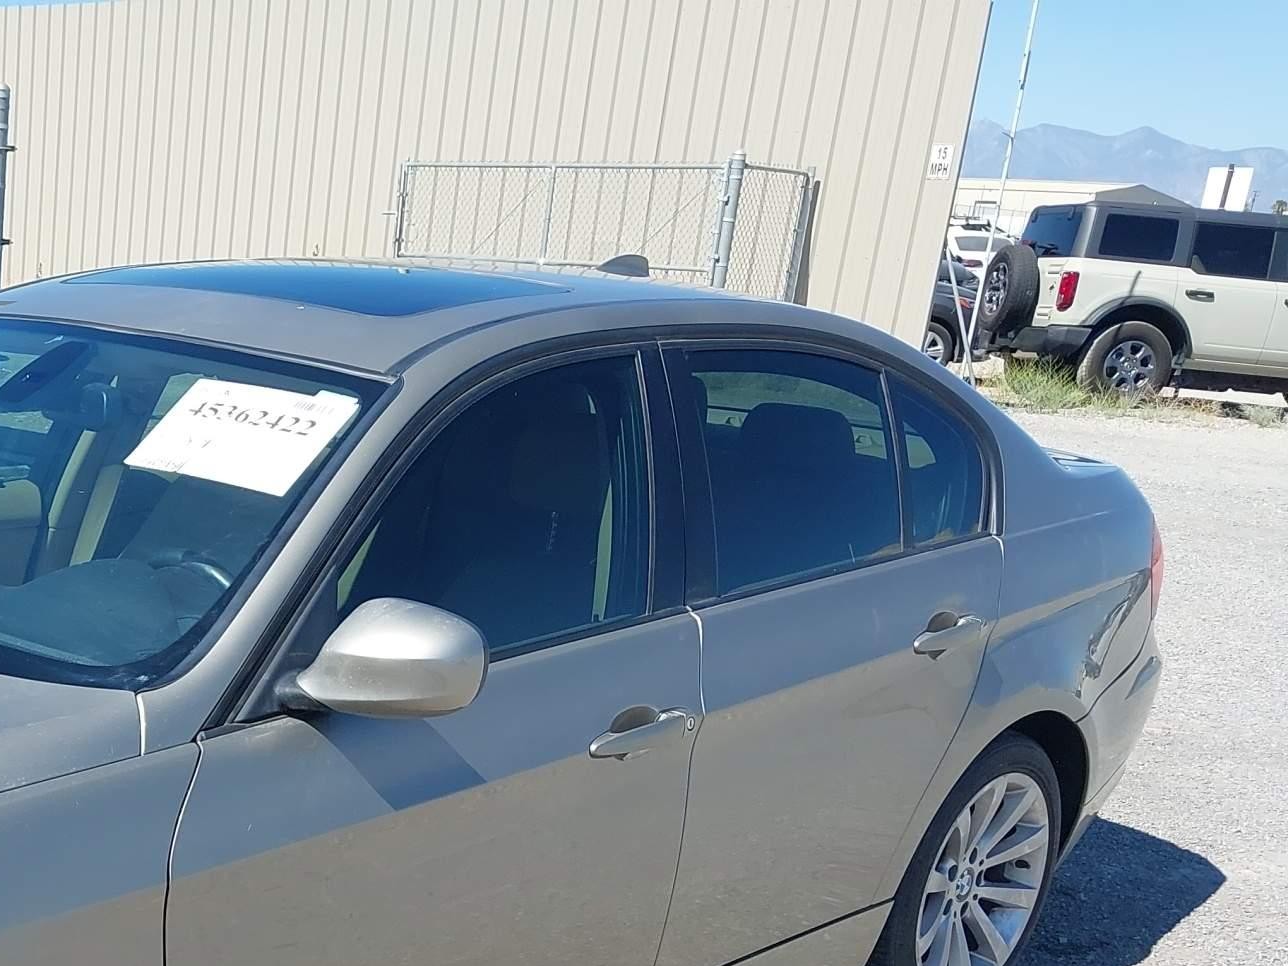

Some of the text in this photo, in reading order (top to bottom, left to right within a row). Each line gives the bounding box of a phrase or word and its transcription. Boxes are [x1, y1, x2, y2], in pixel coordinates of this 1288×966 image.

[937, 146, 948, 160] 15
[929, 163, 949, 176] MPH
[189, 401, 317, 437] 45362422
